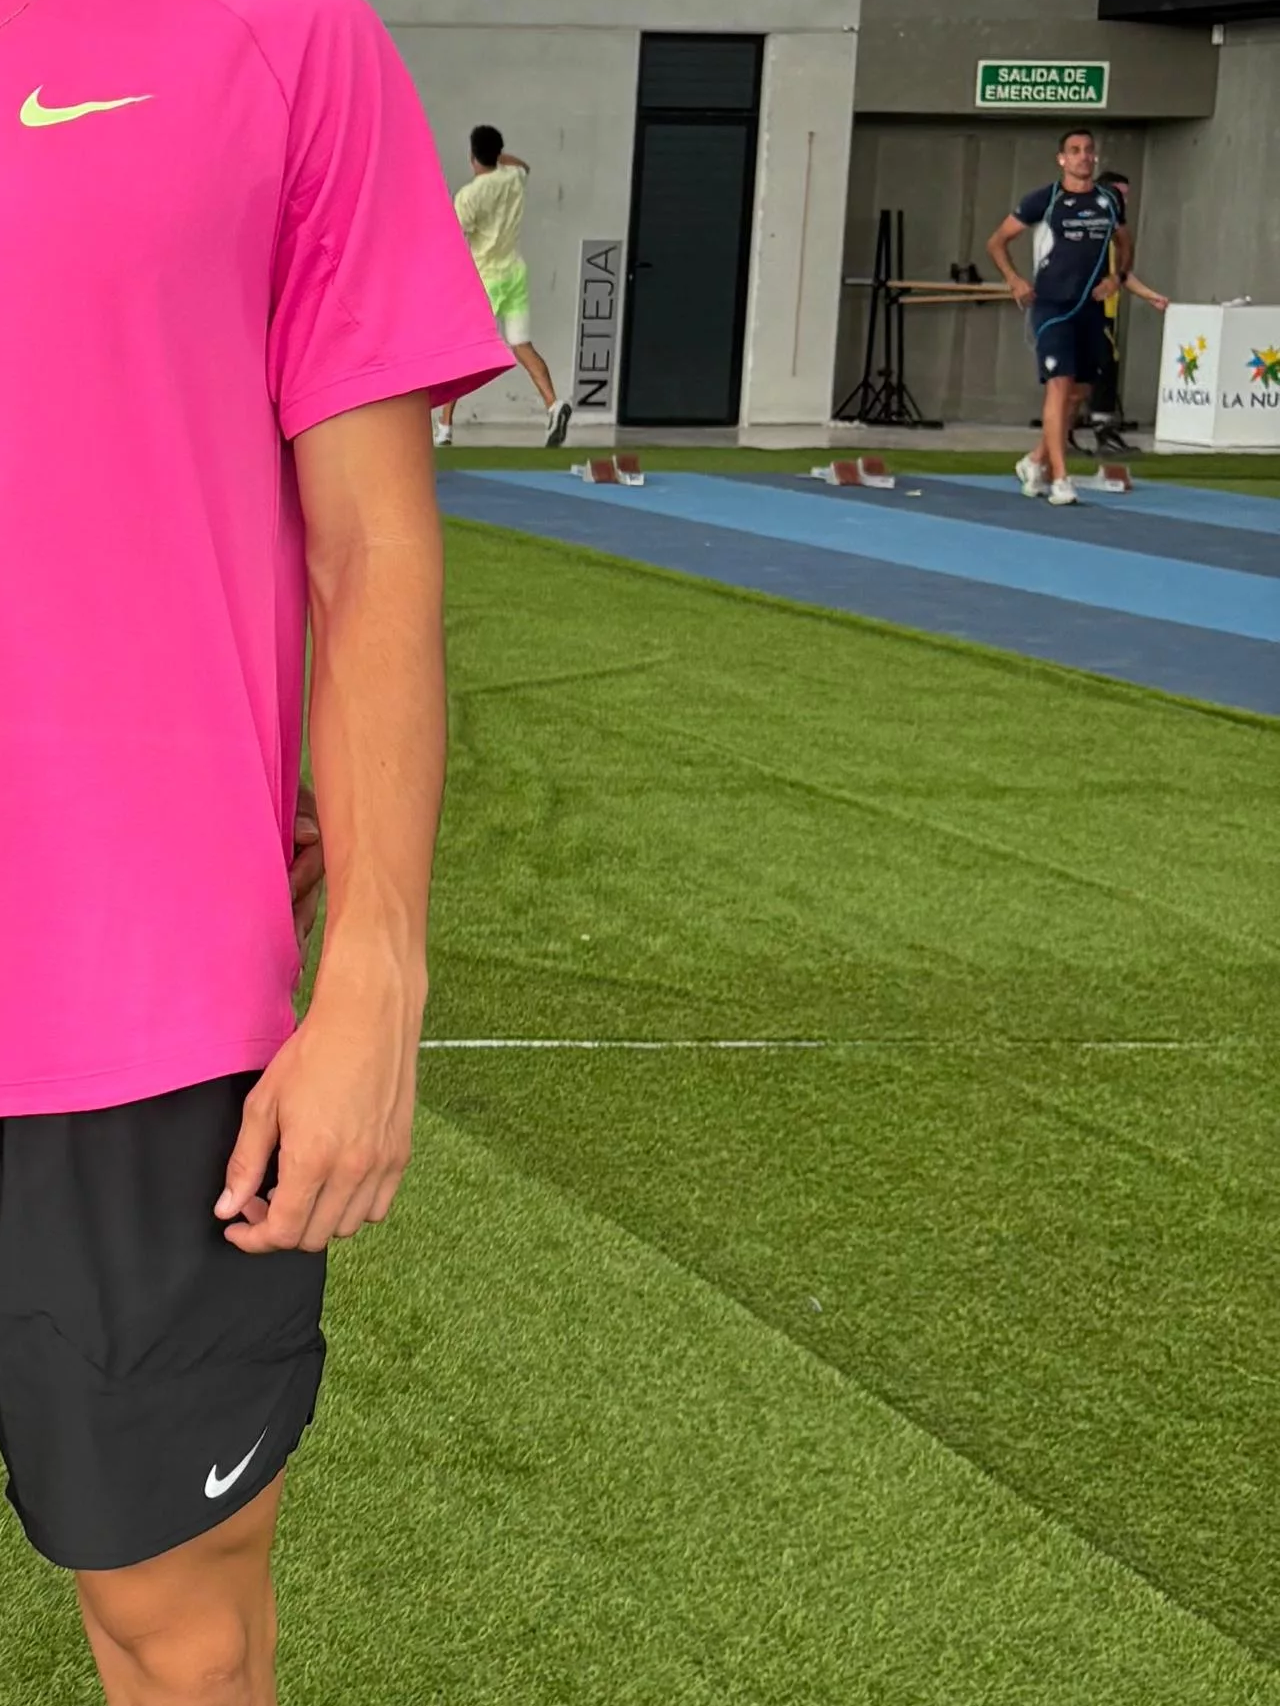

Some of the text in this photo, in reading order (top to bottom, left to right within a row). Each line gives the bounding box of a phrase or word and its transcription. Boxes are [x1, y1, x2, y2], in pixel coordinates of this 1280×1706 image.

[998, 68, 1087, 83] SALIDA DE
[985, 84, 1098, 101] EMERGENCIA
[577, 245, 617, 407] NETEJA
[1222, 392, 1245, 408] LA
